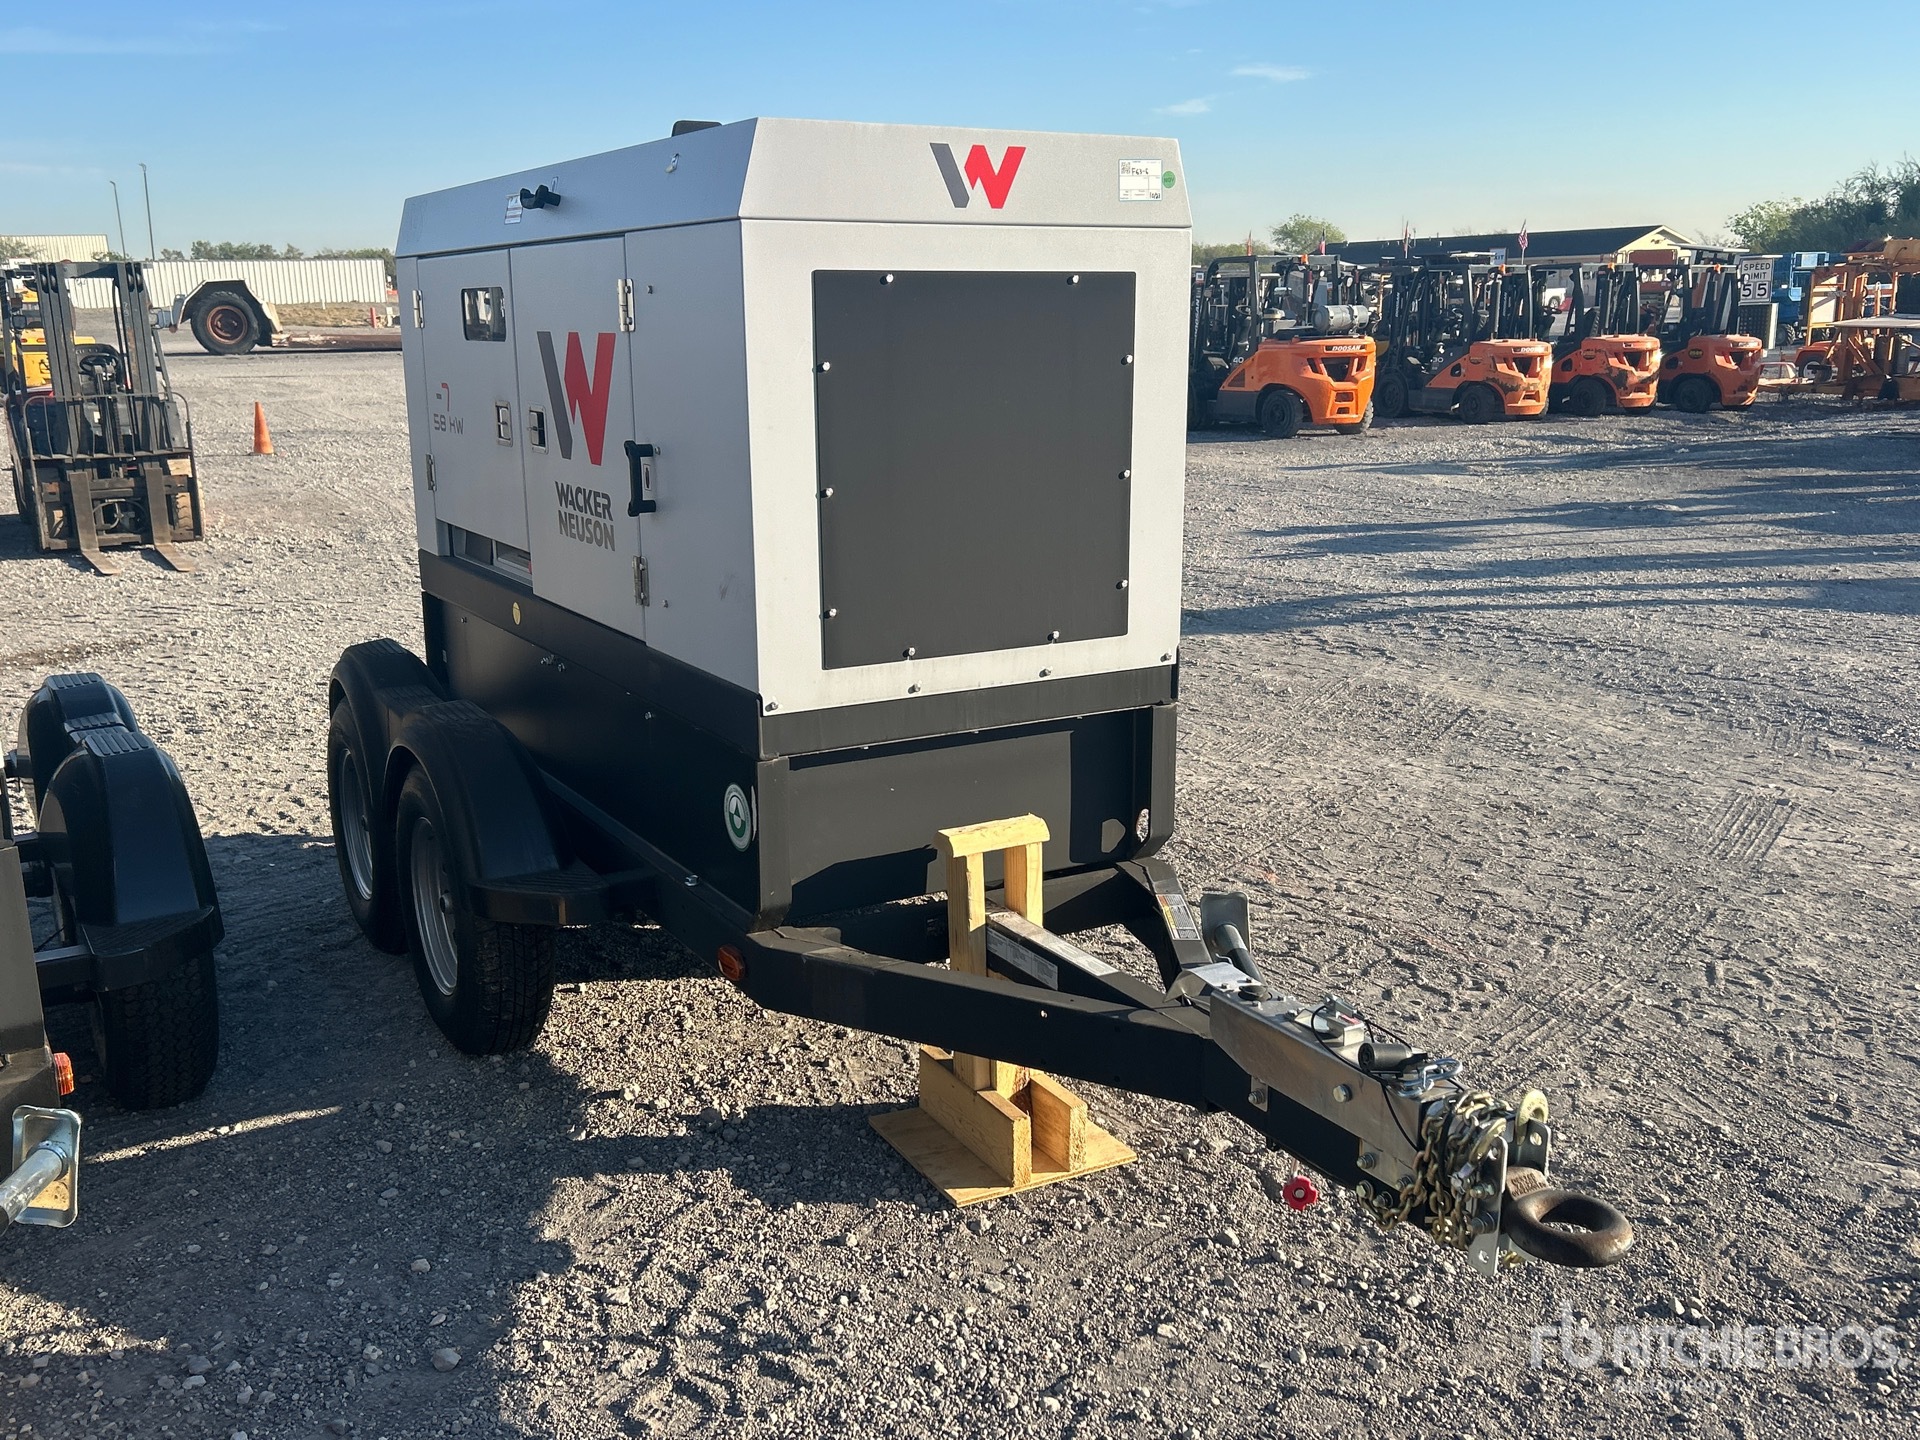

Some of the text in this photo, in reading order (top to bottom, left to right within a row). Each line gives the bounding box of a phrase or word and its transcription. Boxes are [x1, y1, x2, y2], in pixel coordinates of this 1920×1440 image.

[929, 142, 1026, 209] W
[1743, 263, 1771, 271] SPEED
[1750, 272, 1767, 280] IMIT
[1742, 283, 1767, 297] 55
[1232, 356, 1244, 364] 40
[537, 331, 616, 466] W
[433, 413, 447, 432] 58
[555, 481, 614, 521] WACKER
[558, 509, 616, 551] NEUSON
